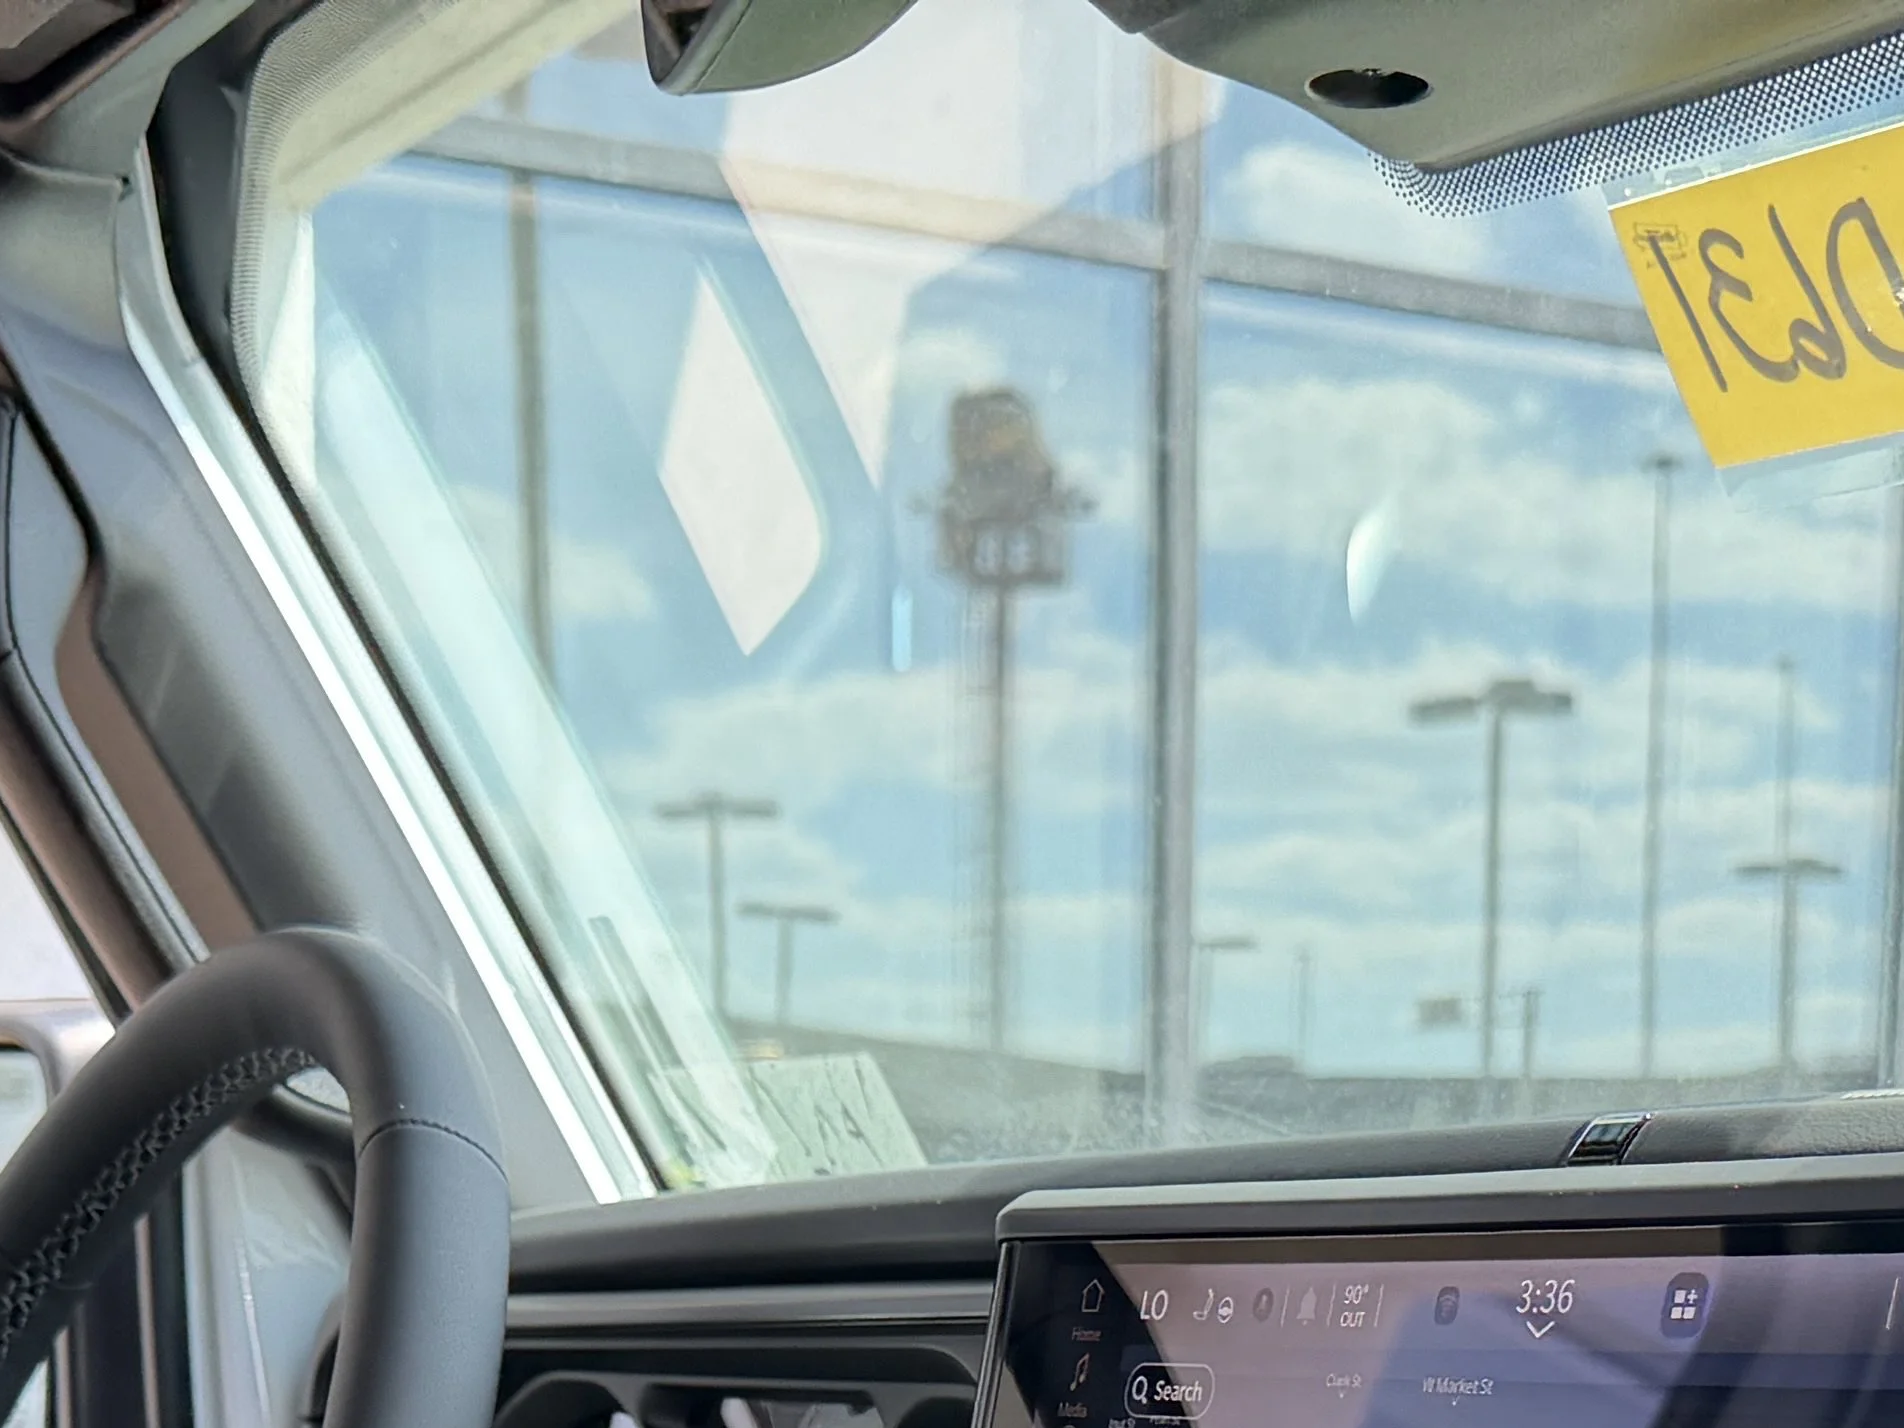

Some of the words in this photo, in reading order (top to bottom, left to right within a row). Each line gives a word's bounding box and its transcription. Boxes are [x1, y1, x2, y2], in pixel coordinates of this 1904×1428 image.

[1139, 1289, 1169, 1321] LO
[1516, 1279, 1575, 1314] 3:36
[1340, 1310, 1366, 1329] OUT
[1153, 1378, 1203, 1403] Search
[1435, 1378, 1479, 1395] Market
[1480, 1379, 1494, 1396] St
[1057, 1402, 1089, 1418] Media
